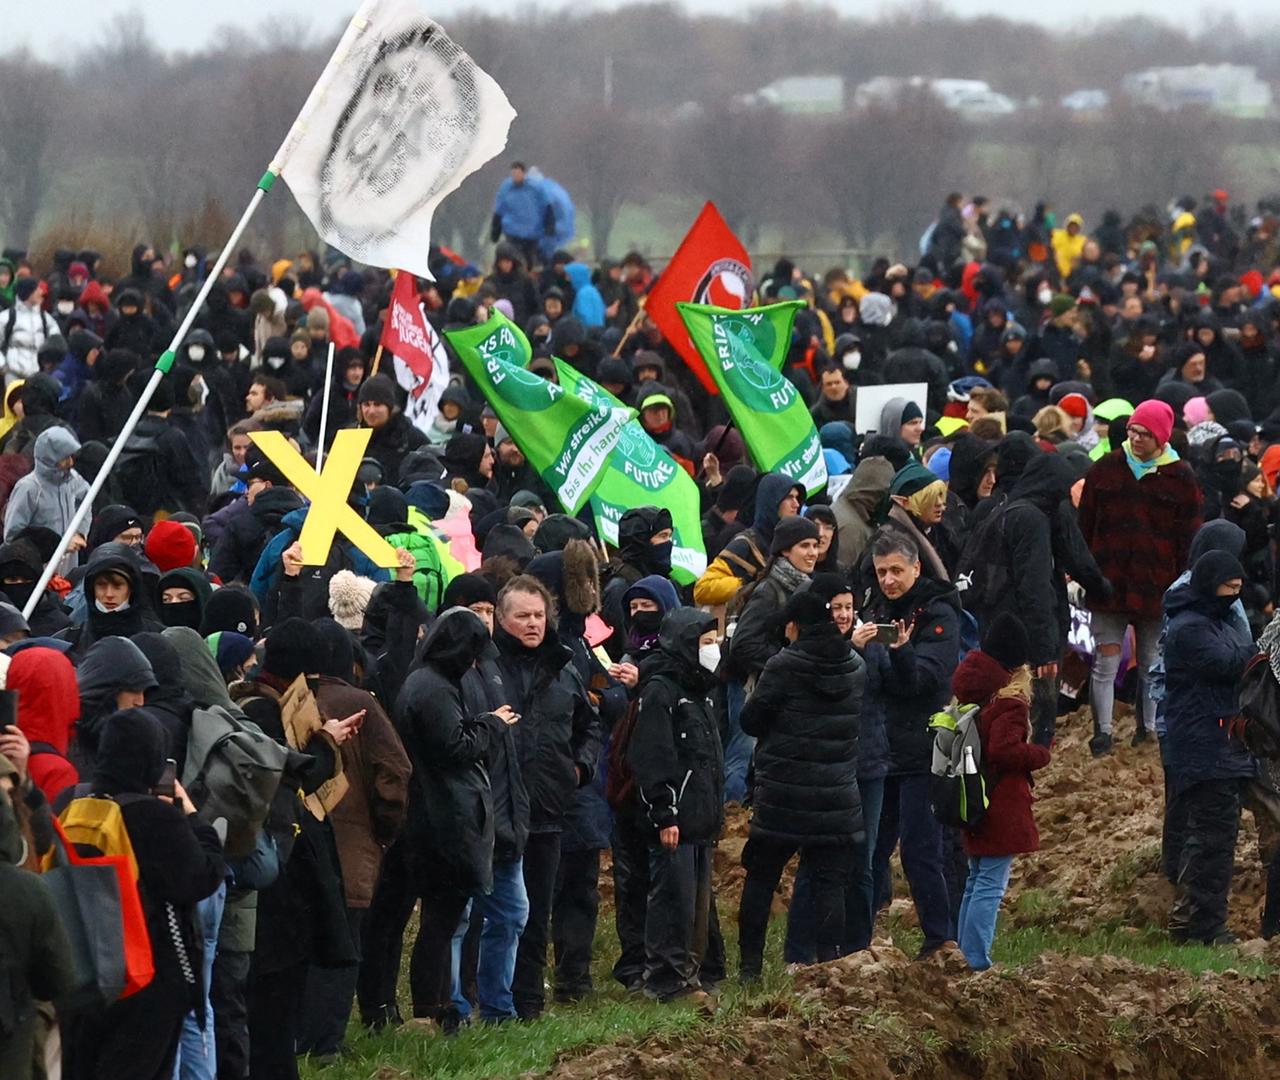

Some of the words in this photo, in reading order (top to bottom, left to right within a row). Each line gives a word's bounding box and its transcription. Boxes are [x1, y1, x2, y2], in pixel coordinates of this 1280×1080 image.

[770, 378, 795, 409] FUT
[555, 449, 572, 476] Wir
[570, 405, 608, 450] streike
[564, 478, 581, 499] bis
[577, 456, 595, 477] Ihr
[624, 460, 674, 488] FUTURE
